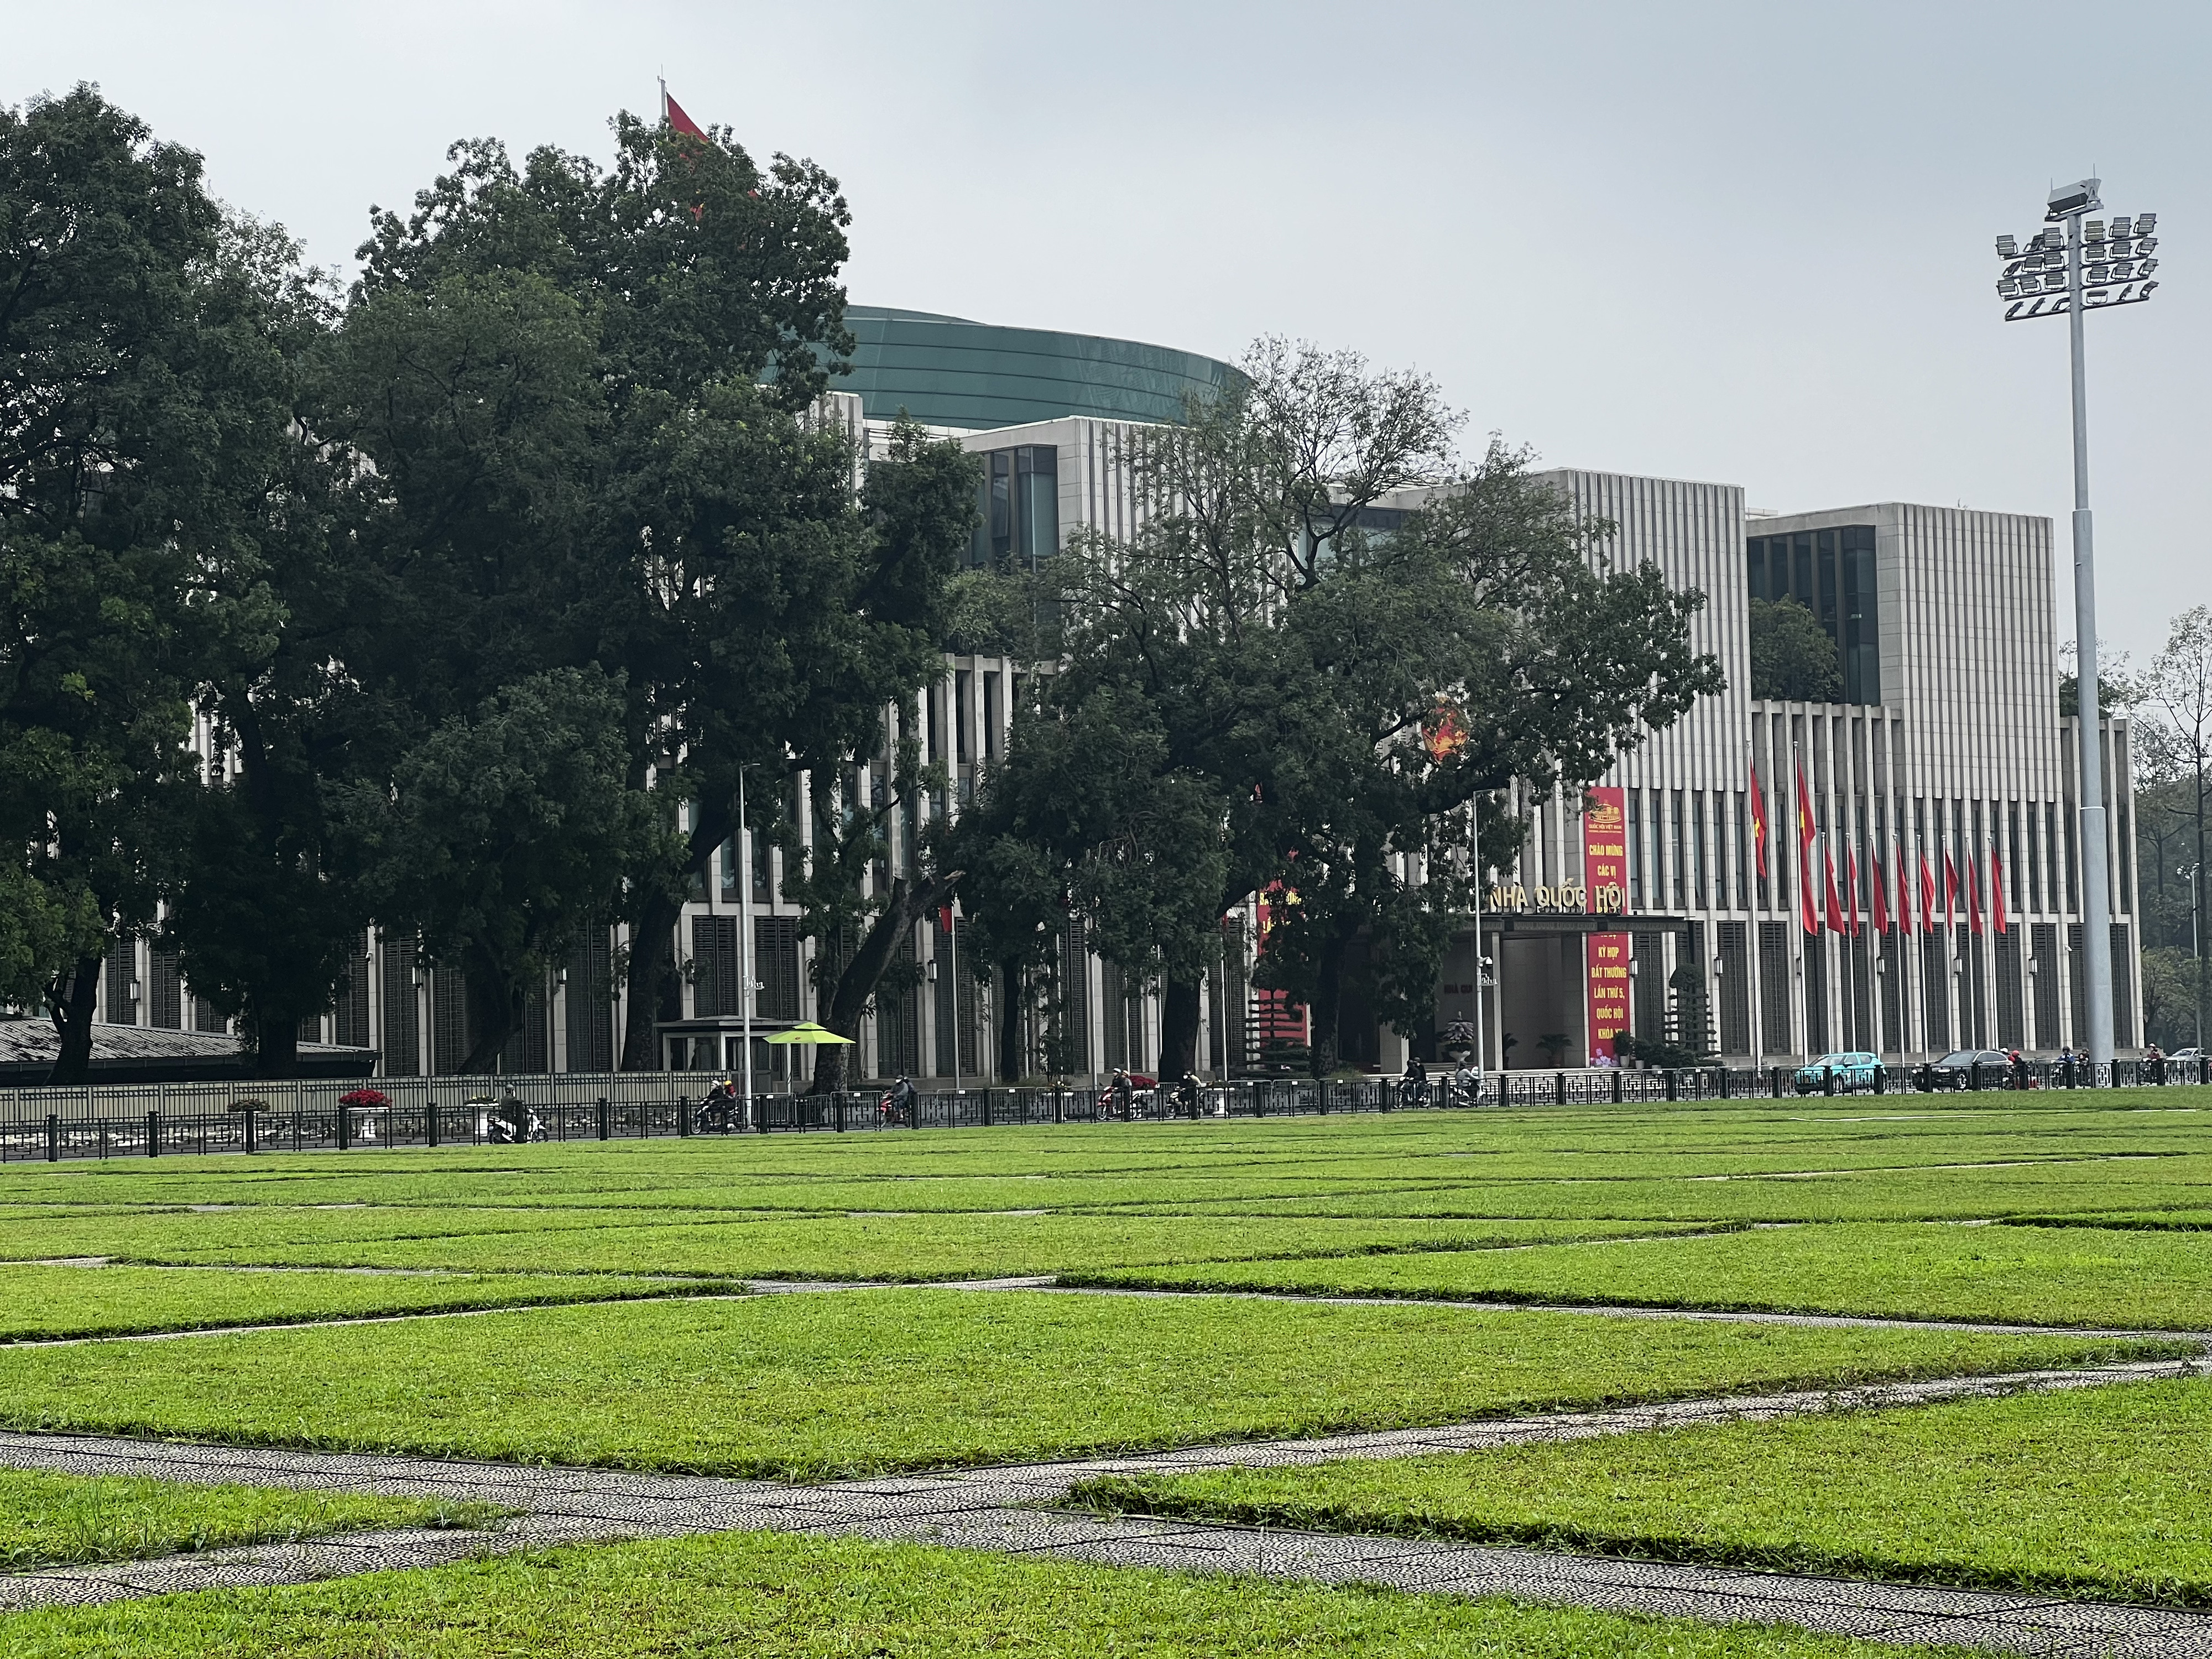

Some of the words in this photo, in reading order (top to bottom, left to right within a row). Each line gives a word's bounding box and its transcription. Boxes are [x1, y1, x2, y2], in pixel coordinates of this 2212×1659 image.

[1589, 842, 1605, 856] CHÀO
[1605, 843, 1624, 857] MỪNG
[1597, 863, 1609, 877] CÁC
[1610, 865, 1616, 879] VỊ
[1490, 881, 1528, 907] NHÀ
[1534, 878, 1587, 908] QUỐC
[1598, 944, 1606, 958] KỲ
[1607, 947, 1619, 961] HỌP
[1591, 963, 1603, 978] BẤT
[1604, 964, 1627, 978] THƯỜNG
[1594, 984, 1606, 998] LẦN
[1606, 985, 1619, 999] THỨ
[1619, 988, 1625, 1000] 5,
[1596, 1004, 1613, 1020] QUỐC
[1613, 1005, 1624, 1021] HỘI
[1598, 1026, 1614, 1040] KHÓA
